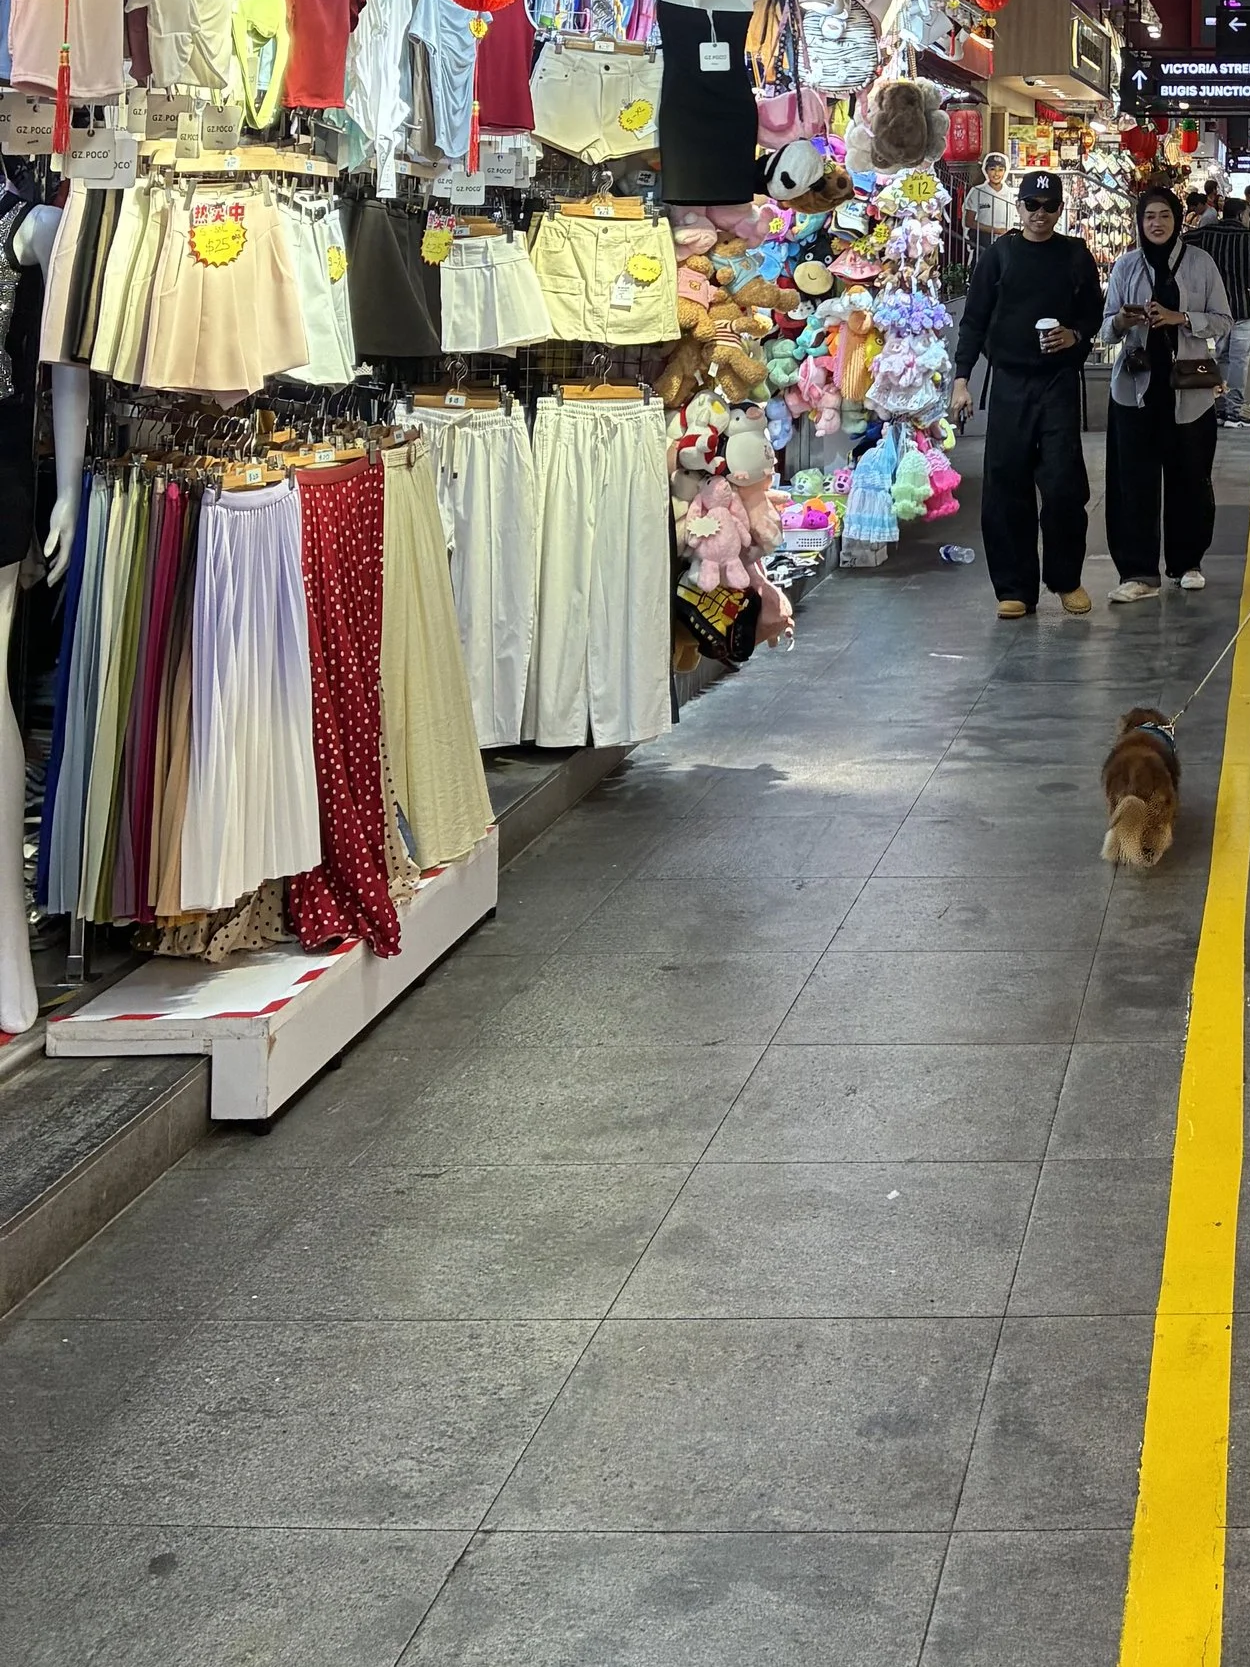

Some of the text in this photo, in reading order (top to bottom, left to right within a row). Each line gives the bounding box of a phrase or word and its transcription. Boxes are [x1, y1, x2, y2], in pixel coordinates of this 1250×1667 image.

[1160, 63, 1218, 75] VICTORIA
[1160, 85, 1198, 97] BUGIS
[152, 114, 178, 122] GZ.PO
[206, 124, 234, 133] GZ.POCO
[71, 150, 110, 160] GZ.POCO
[1036, 175, 1050, 189] NY
